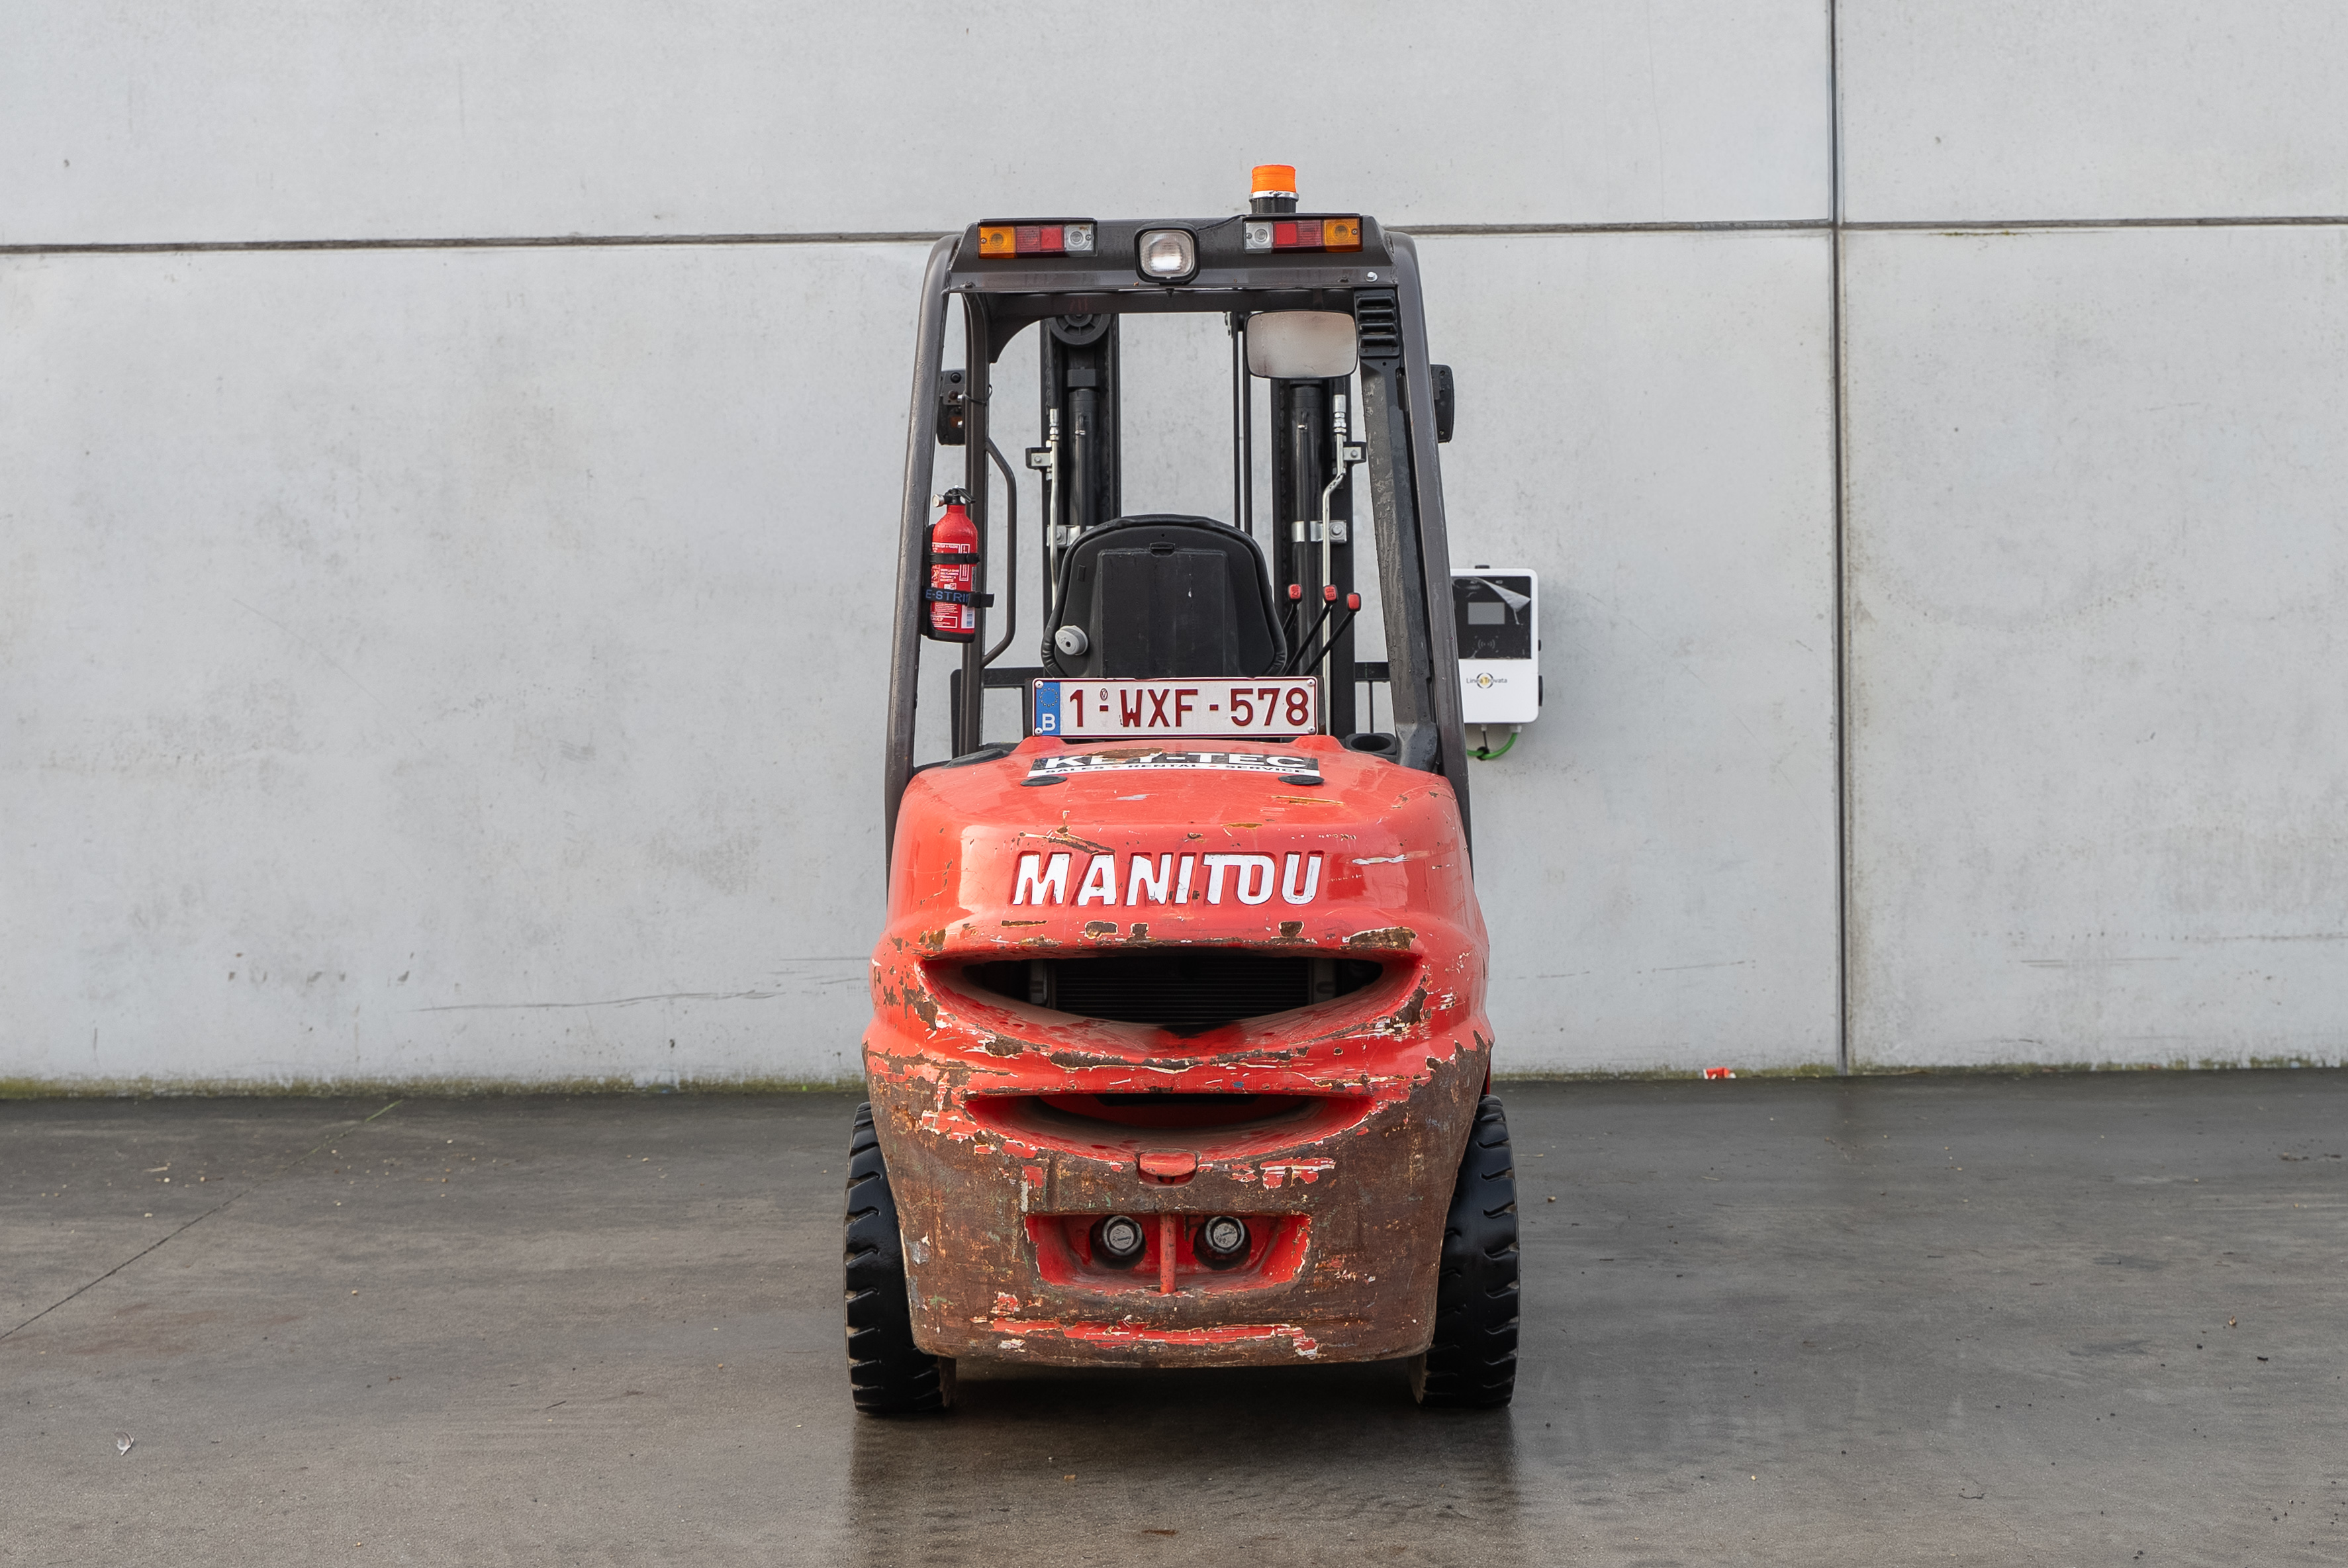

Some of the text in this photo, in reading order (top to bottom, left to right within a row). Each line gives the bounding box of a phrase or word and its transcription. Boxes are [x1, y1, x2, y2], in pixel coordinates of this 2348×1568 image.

[1042, 714, 1056, 731] B
[1070, 687, 1309, 727] 1-WXF-578
[1013, 853, 1322, 906] MANITOU
